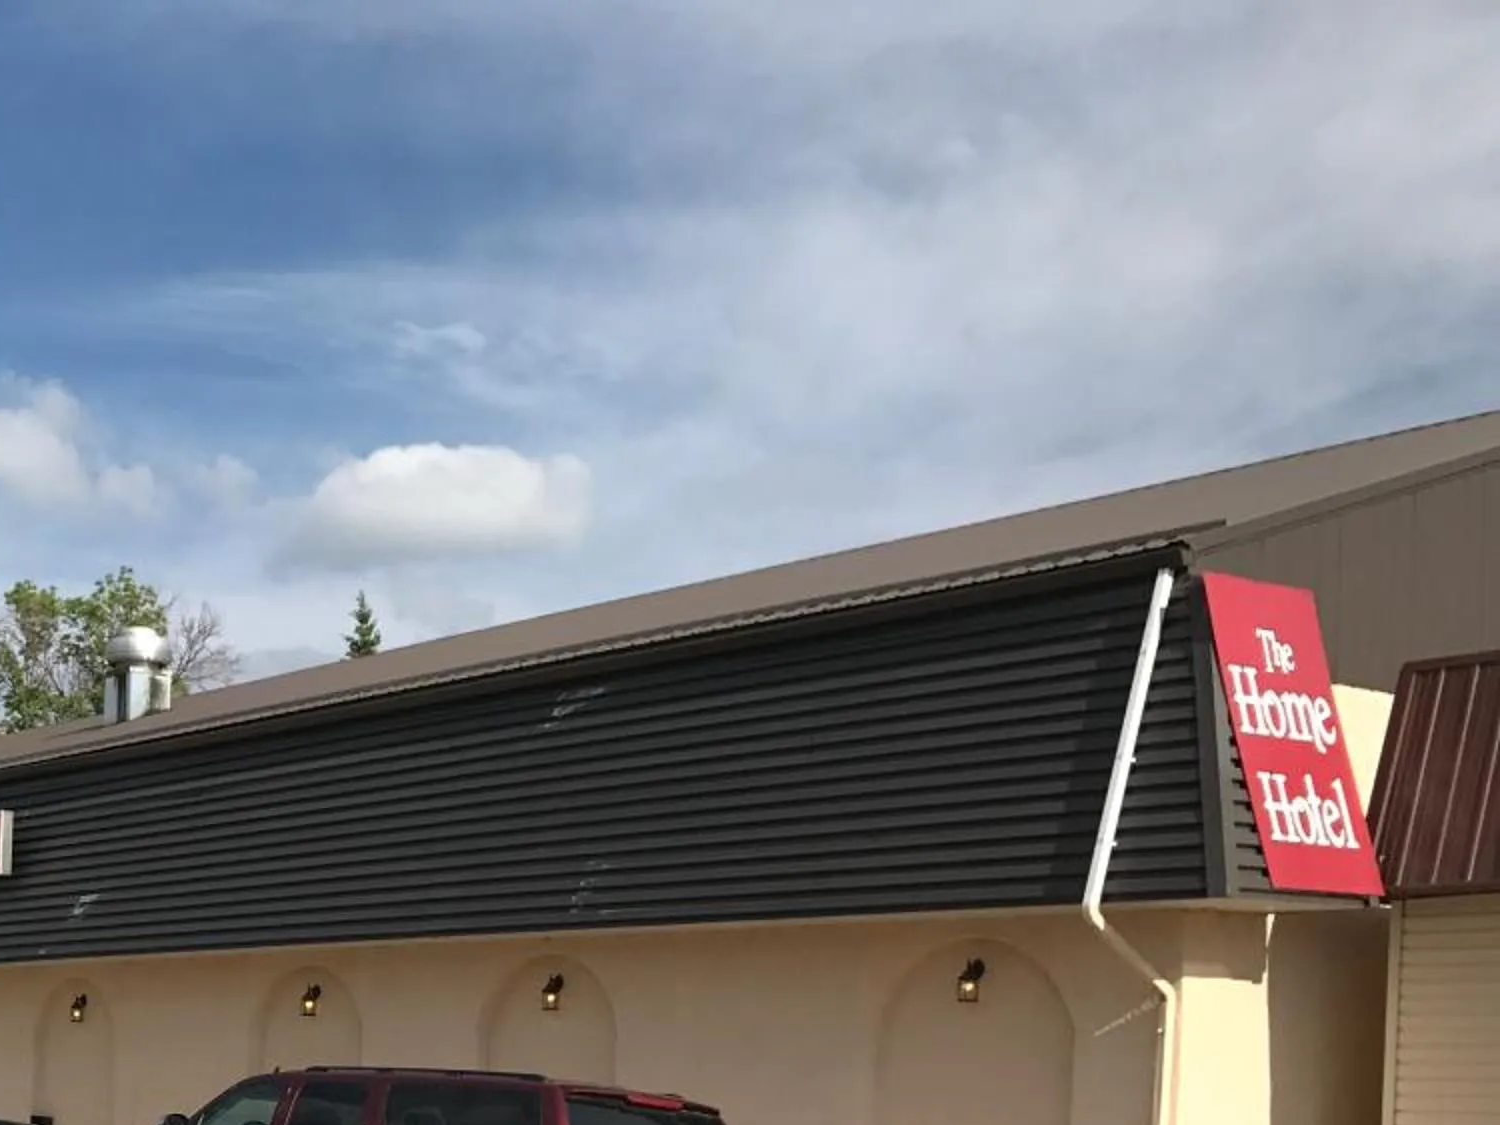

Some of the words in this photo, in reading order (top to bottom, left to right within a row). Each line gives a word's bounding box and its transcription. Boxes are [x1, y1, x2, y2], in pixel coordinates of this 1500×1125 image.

[1256, 627, 1295, 674] The
[1228, 664, 1337, 755] Home
[1256, 770, 1361, 850] Hotel
